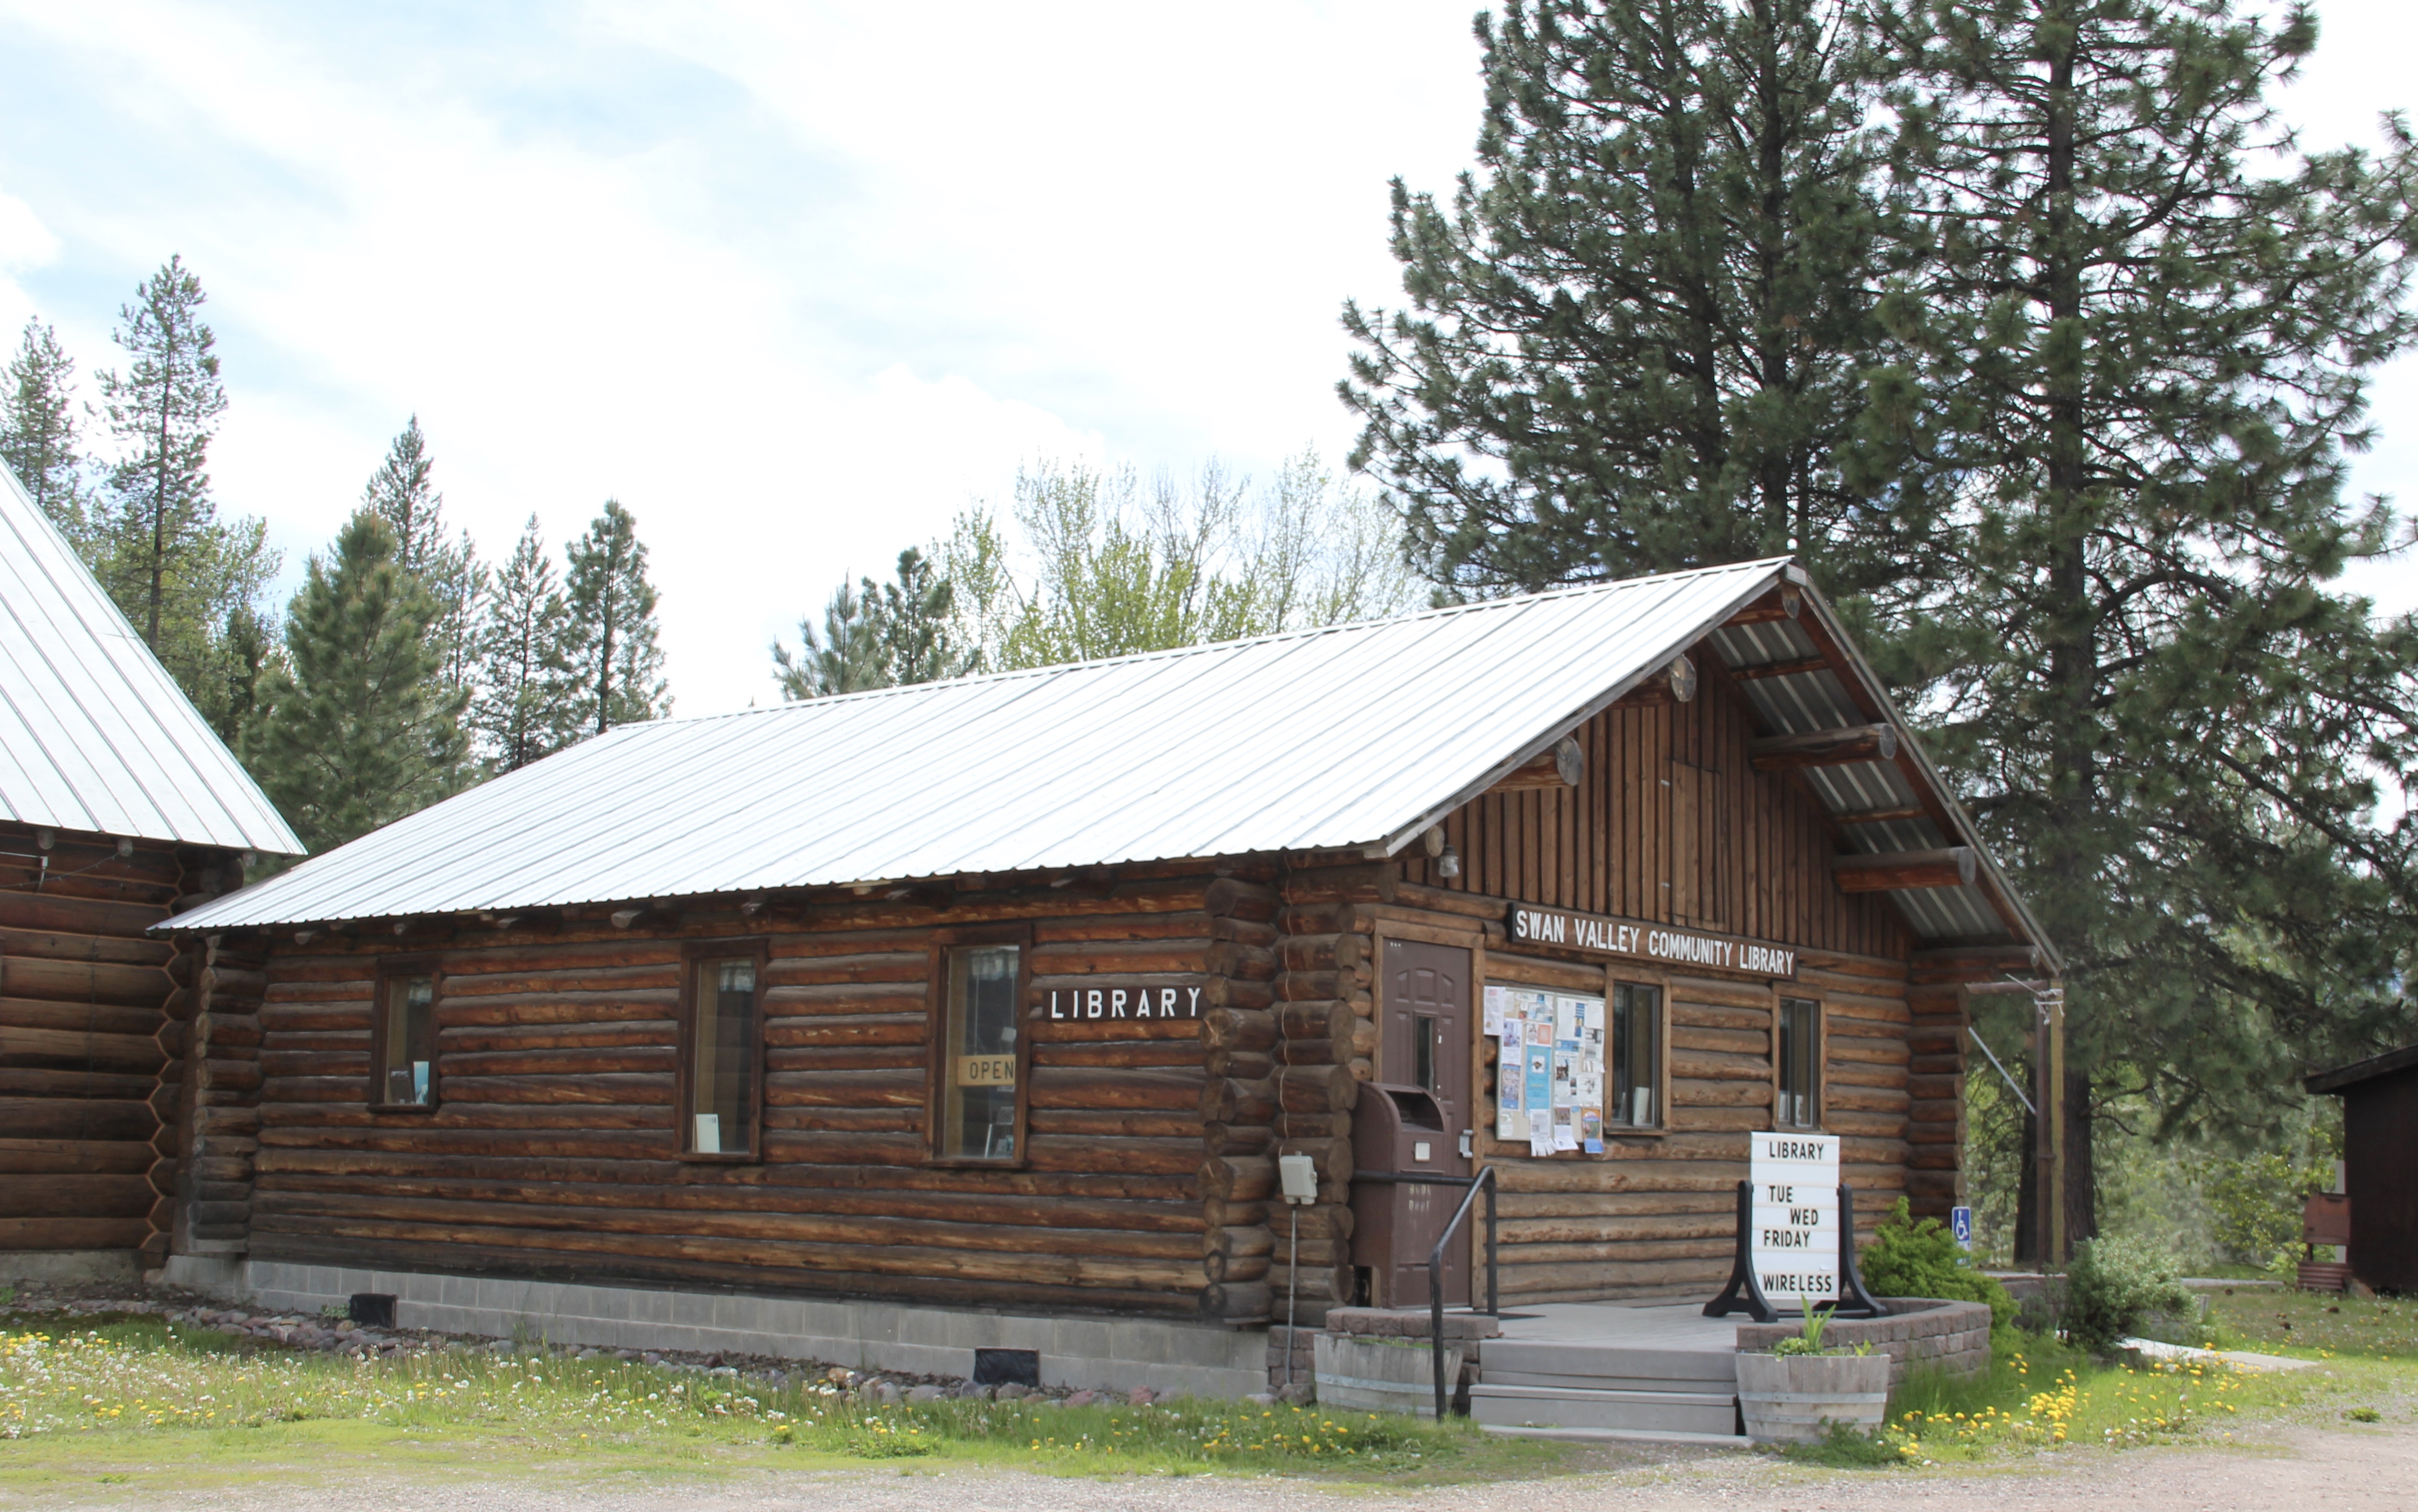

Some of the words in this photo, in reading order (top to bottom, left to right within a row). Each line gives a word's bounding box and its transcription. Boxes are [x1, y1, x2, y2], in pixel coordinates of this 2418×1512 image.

[1516, 909, 1565, 943] SWAN
[1574, 918, 1640, 954] VALLEY
[1648, 930, 1733, 967] COMMUNITY
[1739, 944, 1794, 976] LIBRARY
[1051, 987, 1201, 1019] LIBRARY
[970, 1060, 1013, 1080] OPEN
[1769, 1141, 1824, 1160] LIBRARY
[1768, 1185, 1793, 1203] TUE
[1790, 1208, 1819, 1226] WED
[1764, 1230, 1810, 1247] FRIDAY
[1763, 1274, 1832, 1293] WIRELESS
